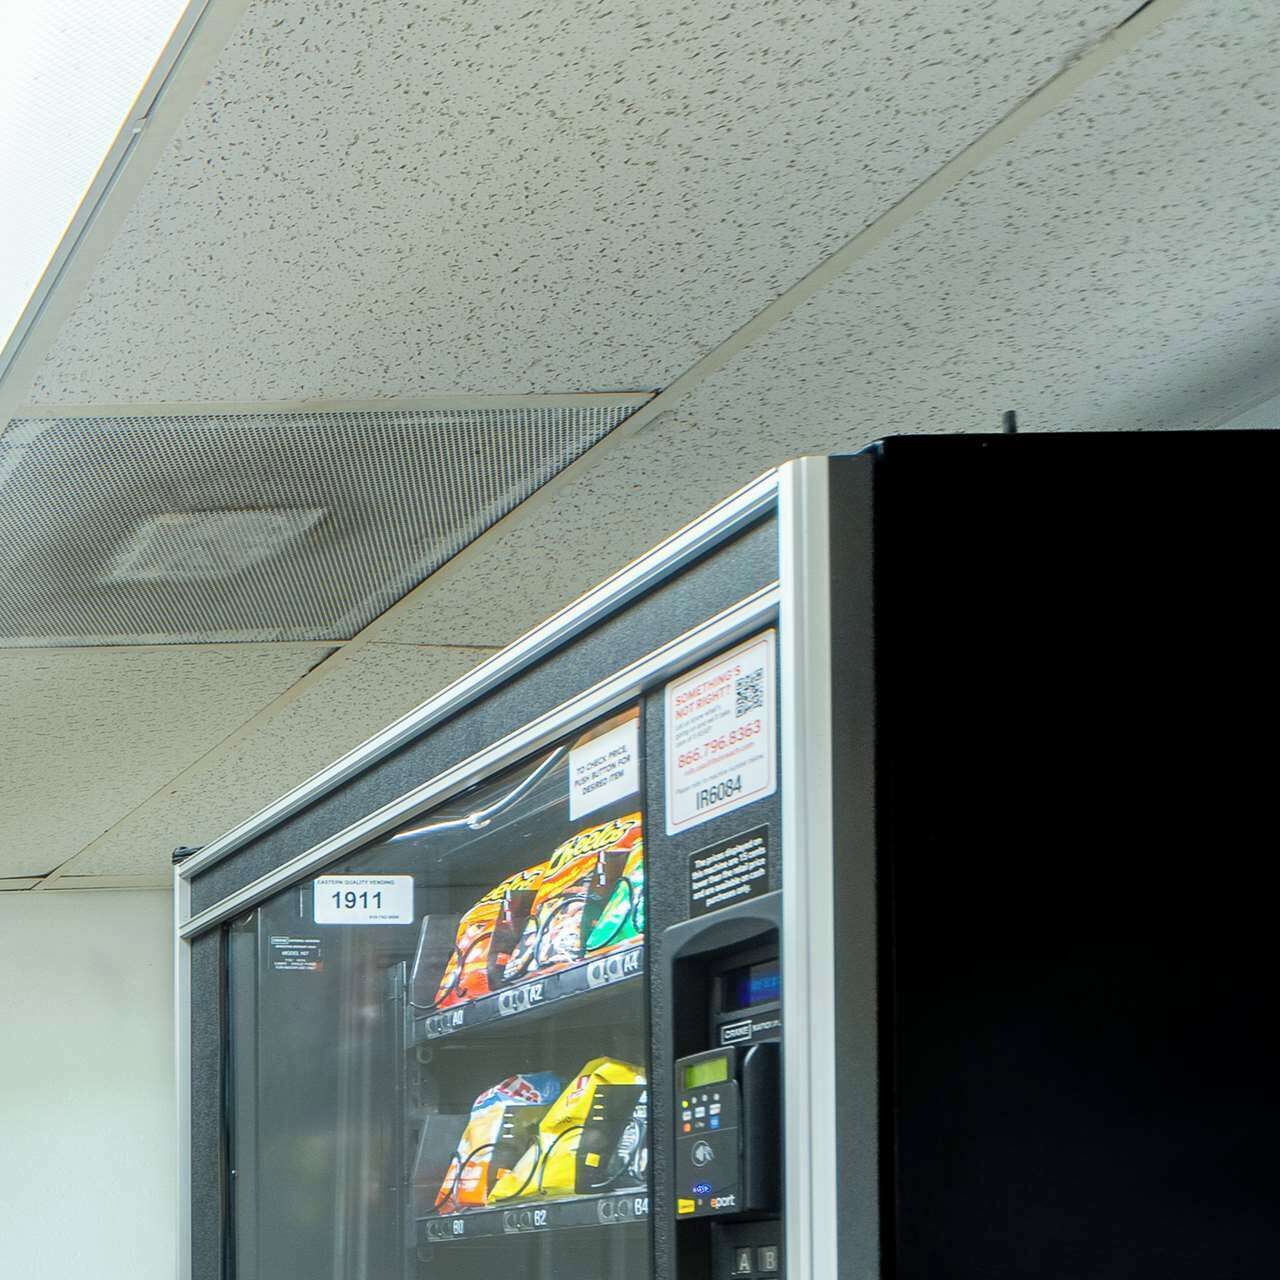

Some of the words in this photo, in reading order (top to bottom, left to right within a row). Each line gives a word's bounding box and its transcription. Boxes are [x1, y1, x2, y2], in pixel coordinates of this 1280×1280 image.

[675, 701, 695, 721] NOT
[696, 683, 731, 711] RIGHT?
[678, 718, 761, 770] 866.796.8363
[575, 774, 589, 789] PUSH
[592, 761, 616, 781] BUTTON
[618, 754, 630, 768] FOR
[586, 753, 607, 772] CHECK
[582, 775, 608, 796] DESIRED
[696, 773, 743, 811] IR6084
[332, 891, 382, 909] 1911
[624, 958, 639, 973] A4
[529, 985, 544, 1002] A2
[634, 1198, 649, 1214] B4
[534, 1210, 547, 1225] B2
[740, 1253, 750, 1271] A
[766, 1251, 776, 1269] B
